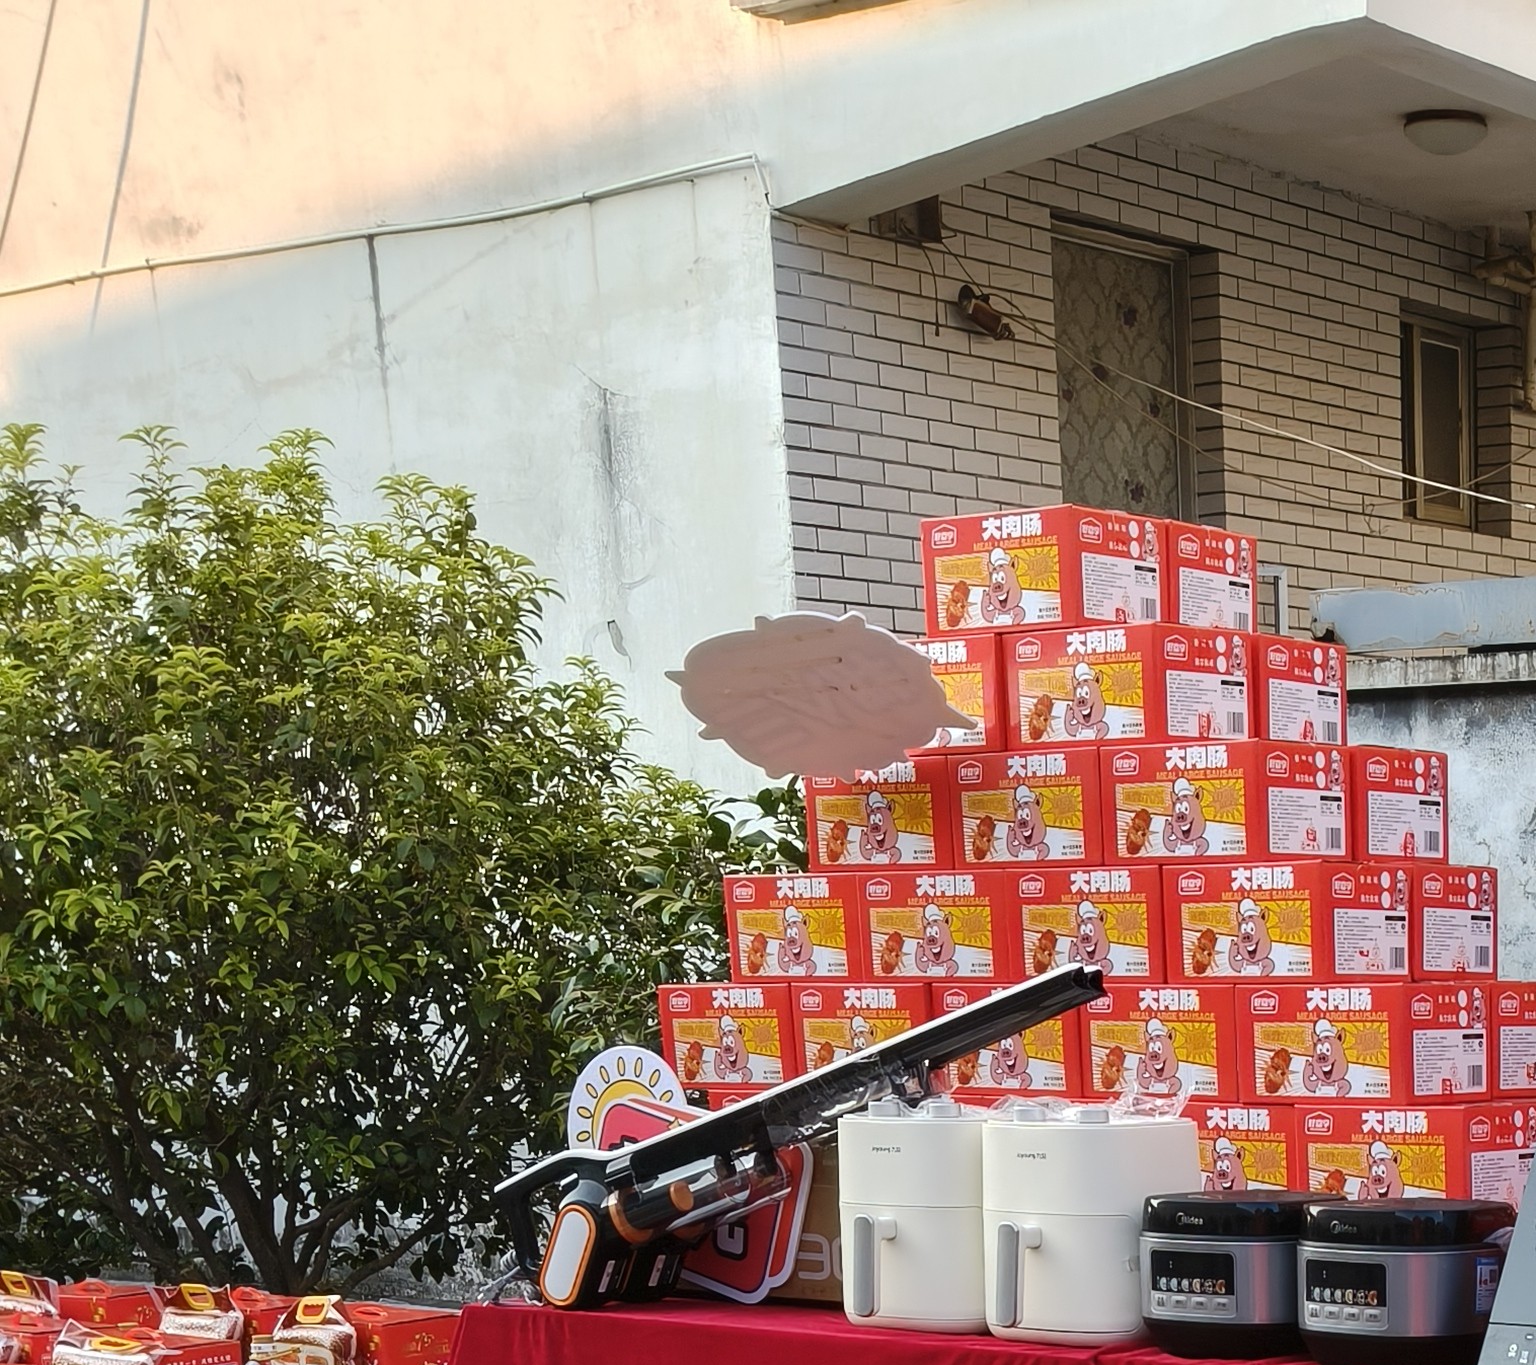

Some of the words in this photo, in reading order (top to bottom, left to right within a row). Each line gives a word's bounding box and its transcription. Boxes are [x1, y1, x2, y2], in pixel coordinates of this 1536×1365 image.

[981, 513, 1042, 540] 大肉肠
[1066, 630, 1127, 654] 大肉肠
[1007, 754, 1066, 777] 大肉肠
[1166, 745, 1227, 770] 大肉肠
[777, 877, 830, 899] 大肉肠
[916, 875, 975, 897] 大肉肠
[1069, 871, 1131, 894] 大肉肠
[1231, 867, 1295, 890] 大肉肠
[712, 988, 765, 1009] 大肉肠
[843, 988, 897, 1010] 大肉肠
[1138, 988, 1200, 1011] 大肉肠
[1306, 988, 1373, 1011] 大肉肠
[1206, 1108, 1271, 1132] 大肉肠
[1361, 1110, 1428, 1135] 大肉肠
